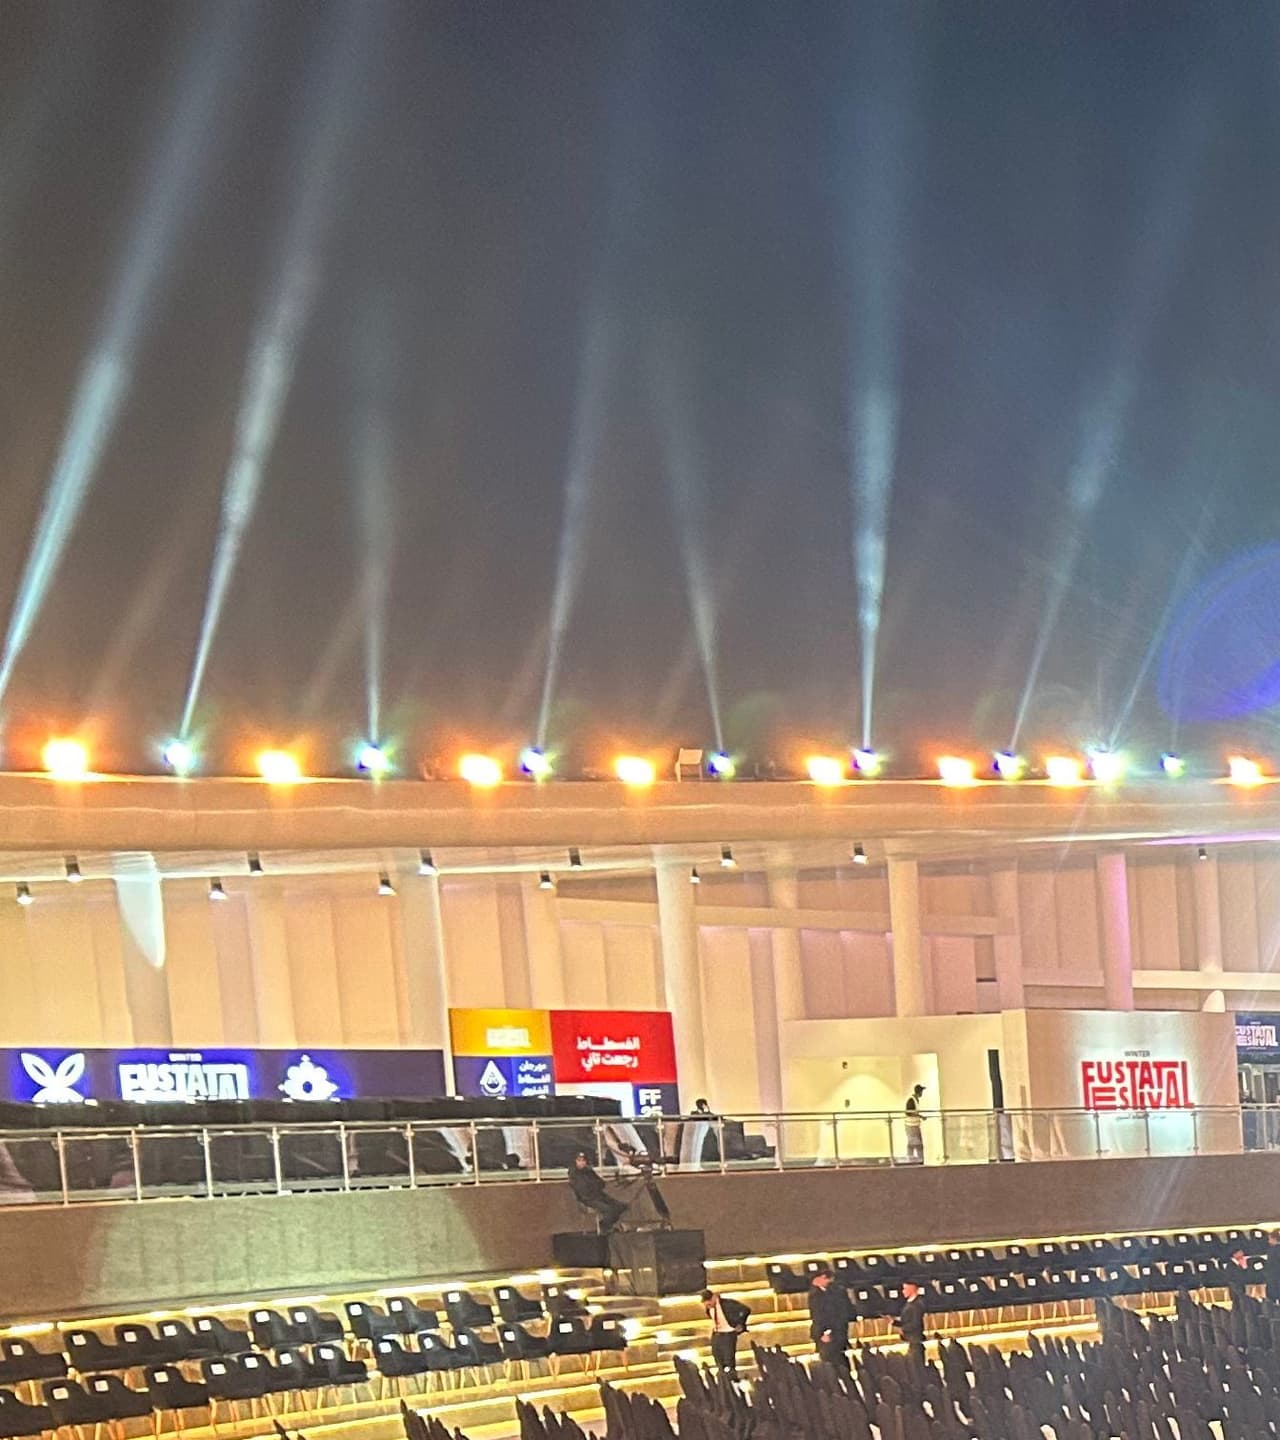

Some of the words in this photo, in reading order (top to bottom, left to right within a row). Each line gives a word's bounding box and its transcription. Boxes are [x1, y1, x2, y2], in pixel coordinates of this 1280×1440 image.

[1124, 1050, 1151, 1058] WINTER
[1081, 1061, 1181, 1090] FUSTAT
[639, 1088, 662, 1105] FF
